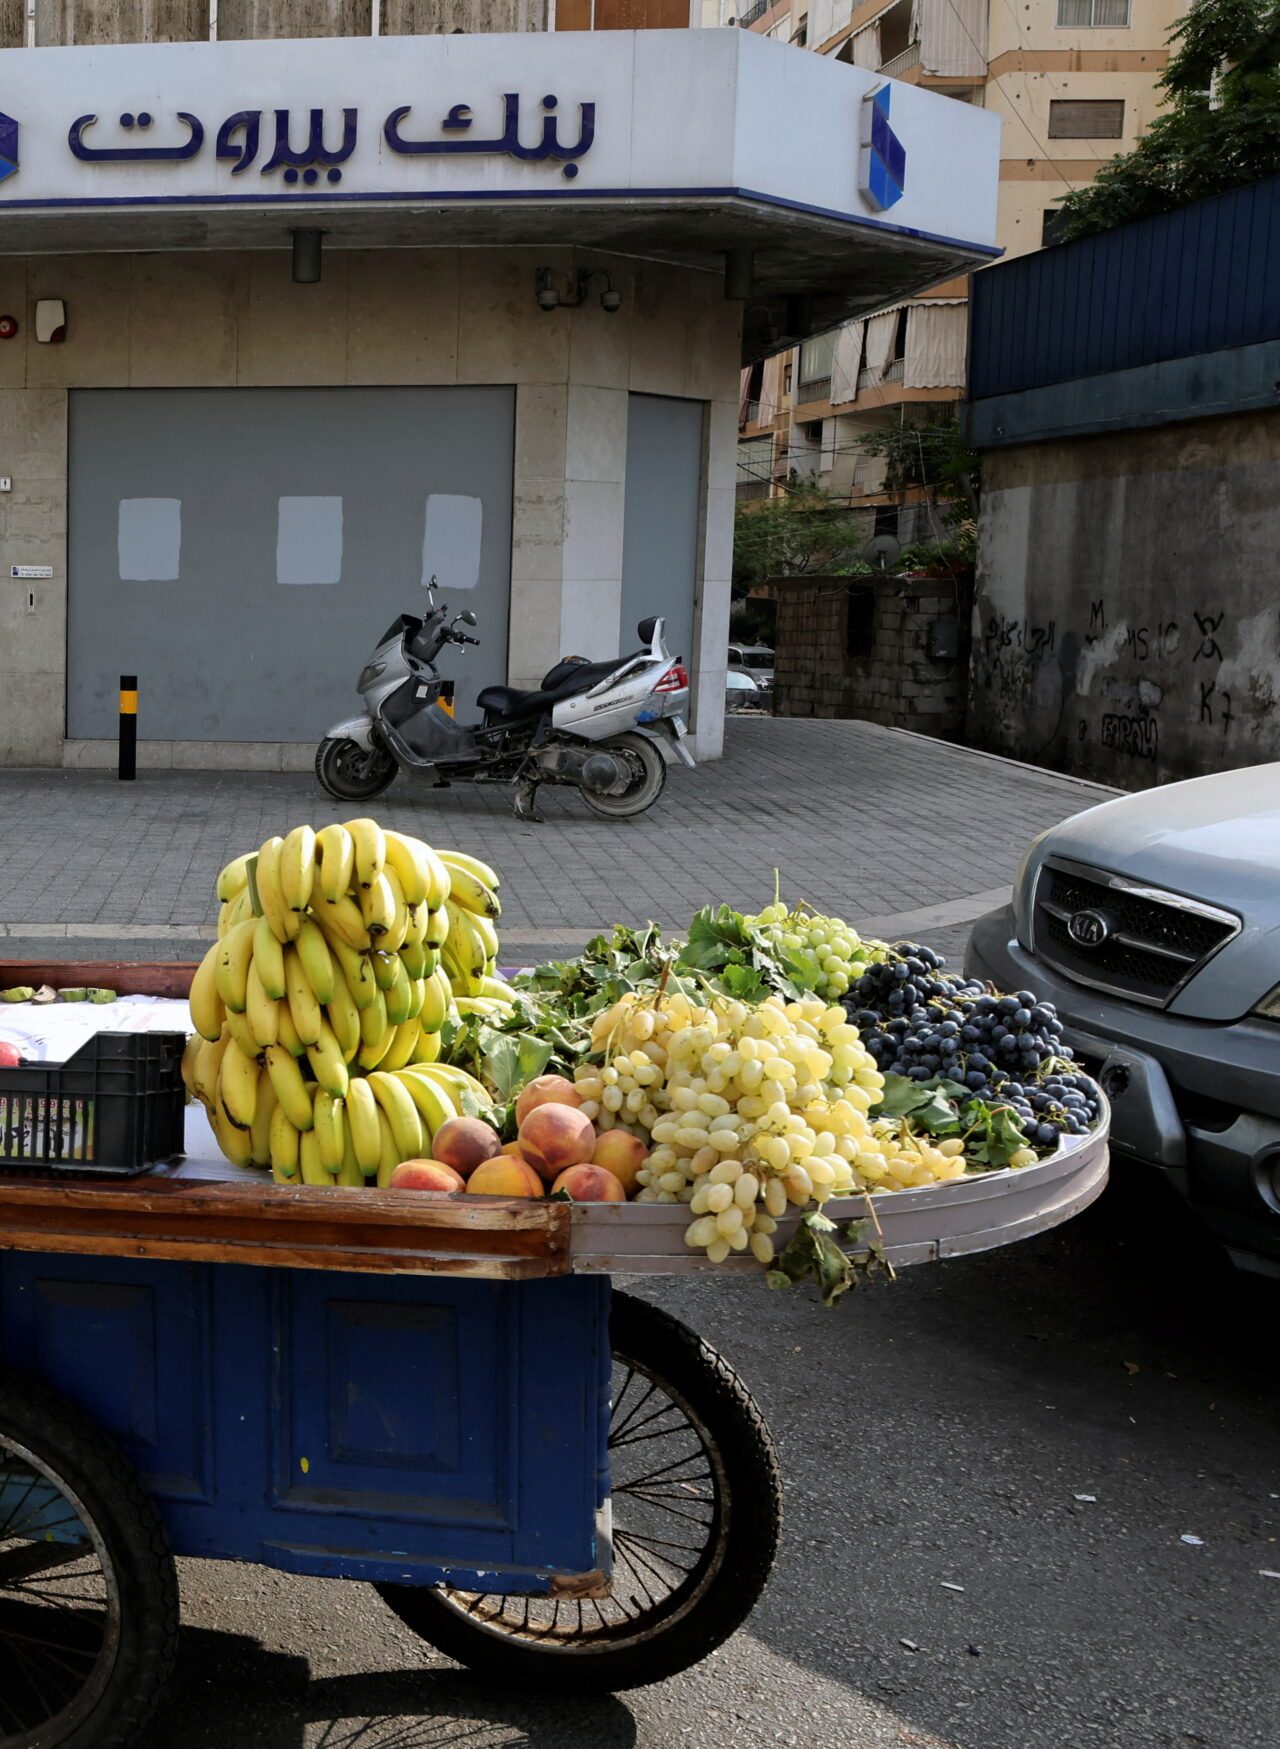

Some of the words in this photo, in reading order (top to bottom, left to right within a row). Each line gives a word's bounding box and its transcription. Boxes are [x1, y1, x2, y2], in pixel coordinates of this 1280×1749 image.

[67, 106, 358, 185] بيروت
[384, 92, 596, 180] بنك
[1072, 915, 1099, 942] KIA
